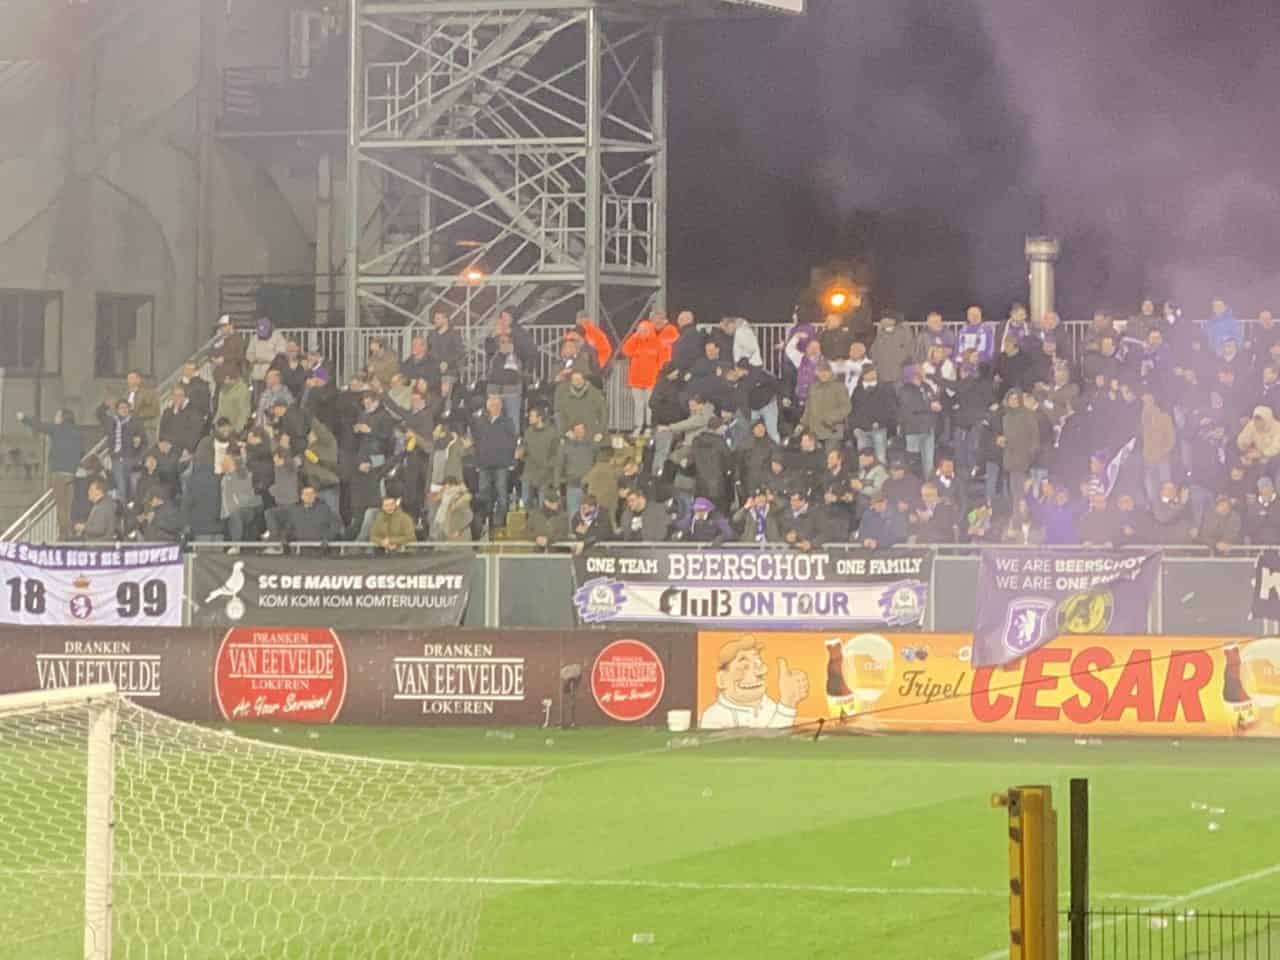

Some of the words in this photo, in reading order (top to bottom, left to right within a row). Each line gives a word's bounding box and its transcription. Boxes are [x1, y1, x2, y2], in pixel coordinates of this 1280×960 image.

[19, 544, 64, 566] SHALL
[66, 550, 97, 566] NOT
[586, 558, 616, 573] ONE
[618, 559, 659, 574] TEAM
[668, 553, 829, 581] BEERSCHOT
[836, 560, 866, 575] ONE
[869, 558, 923, 575] FAMILY
[996, 558, 1020, 572] WE
[1023, 558, 1051, 572] ARE
[258, 575, 279, 589] SC
[281, 575, 302, 589] DE
[304, 575, 363, 589] MAUVE
[365, 574, 464, 589] GESCHELPTE
[996, 575, 1019, 590] WE
[1022, 574, 1051, 590] ARE
[1055, 575, 1088, 590] ONE
[6, 576, 46, 615] 18
[115, 578, 168, 618] 99
[258, 594, 288, 608] KOM
[291, 594, 319, 608] KOM
[322, 594, 353, 608] KOM
[739, 591, 775, 616] ON
[781, 590, 849, 616] TOUR
[64, 641, 131, 653] DRANKEN
[424, 644, 493, 656] DRANKEN
[229, 649, 259, 673] VAN
[262, 649, 334, 674] EETVELDE
[36, 660, 70, 689] VAN
[395, 664, 429, 693] VAN
[435, 664, 525, 695] EETVELDE
[252, 679, 309, 689] LOKEREN
[898, 670, 966, 704] Tripel
[970, 647, 1214, 723] CESAR
[422, 701, 494, 714] LOKEREN
